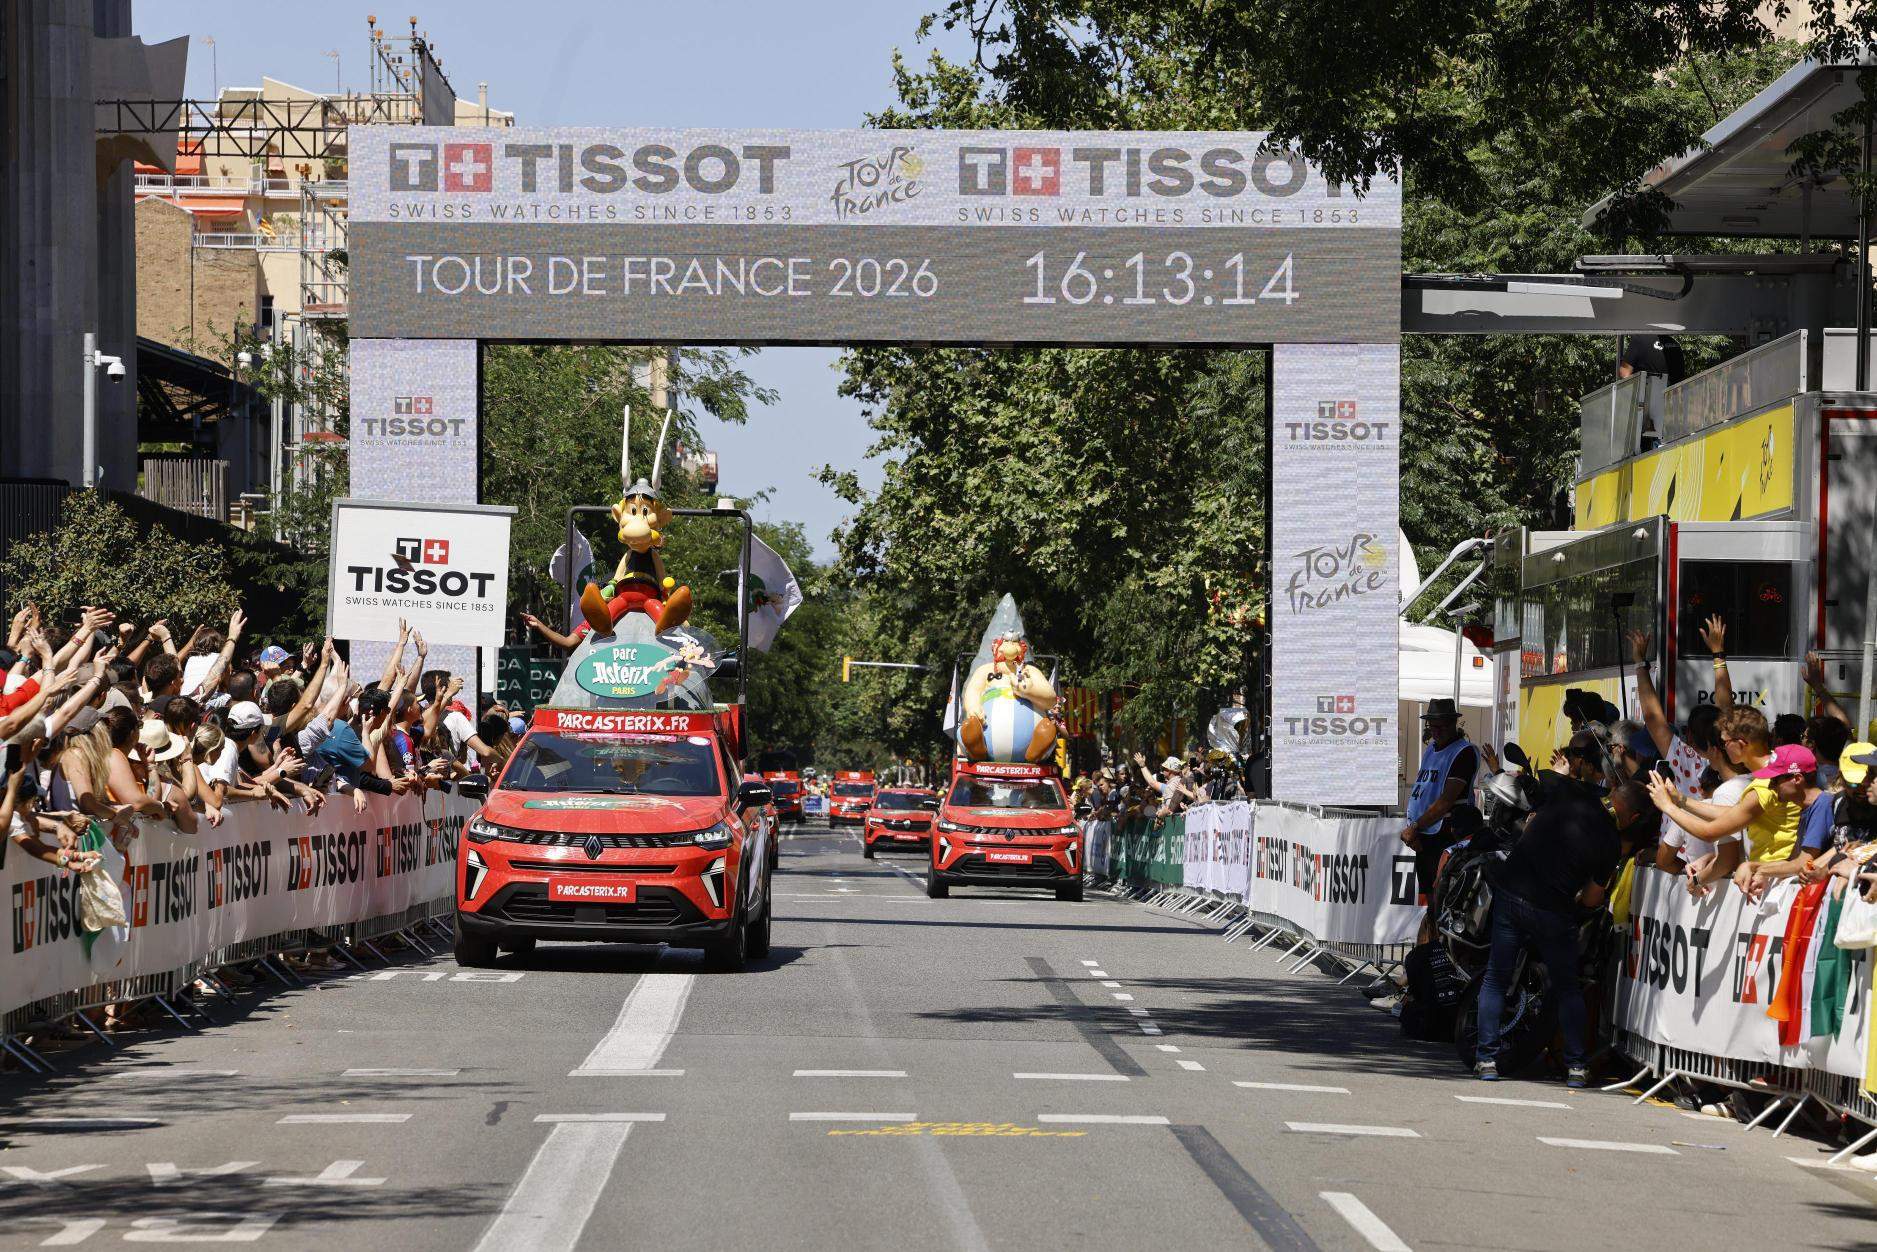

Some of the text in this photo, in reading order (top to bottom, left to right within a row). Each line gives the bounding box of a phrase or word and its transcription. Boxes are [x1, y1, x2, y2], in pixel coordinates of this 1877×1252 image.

[504, 143, 791, 195] TISSOT
[389, 203, 793, 221] SWISS WATCHES SINCE 1853
[958, 207, 1360, 225] SWISS WATCHES SINCE 1853
[406, 250, 1300, 306] TOUR DE FRANCE 2026 16:13:14
[361, 417, 466, 437] TISSOT
[1284, 422, 1389, 441] TISSOT
[345, 596, 494, 612] SWISS WATCHES SINCE 1853
[347, 566, 495, 598] TISSOT
[1284, 717, 1388, 735] TISSOT
[223, 840, 272, 903] TISSOT
[311, 830, 367, 888] TISSOT
[392, 822, 422, 875] TISSOT
[152, 855, 199, 925] TISSOT
[1322, 853, 1369, 905] TISSOT
[37, 874, 83, 946] TISSO
[1639, 915, 1711, 997] TISSOT
